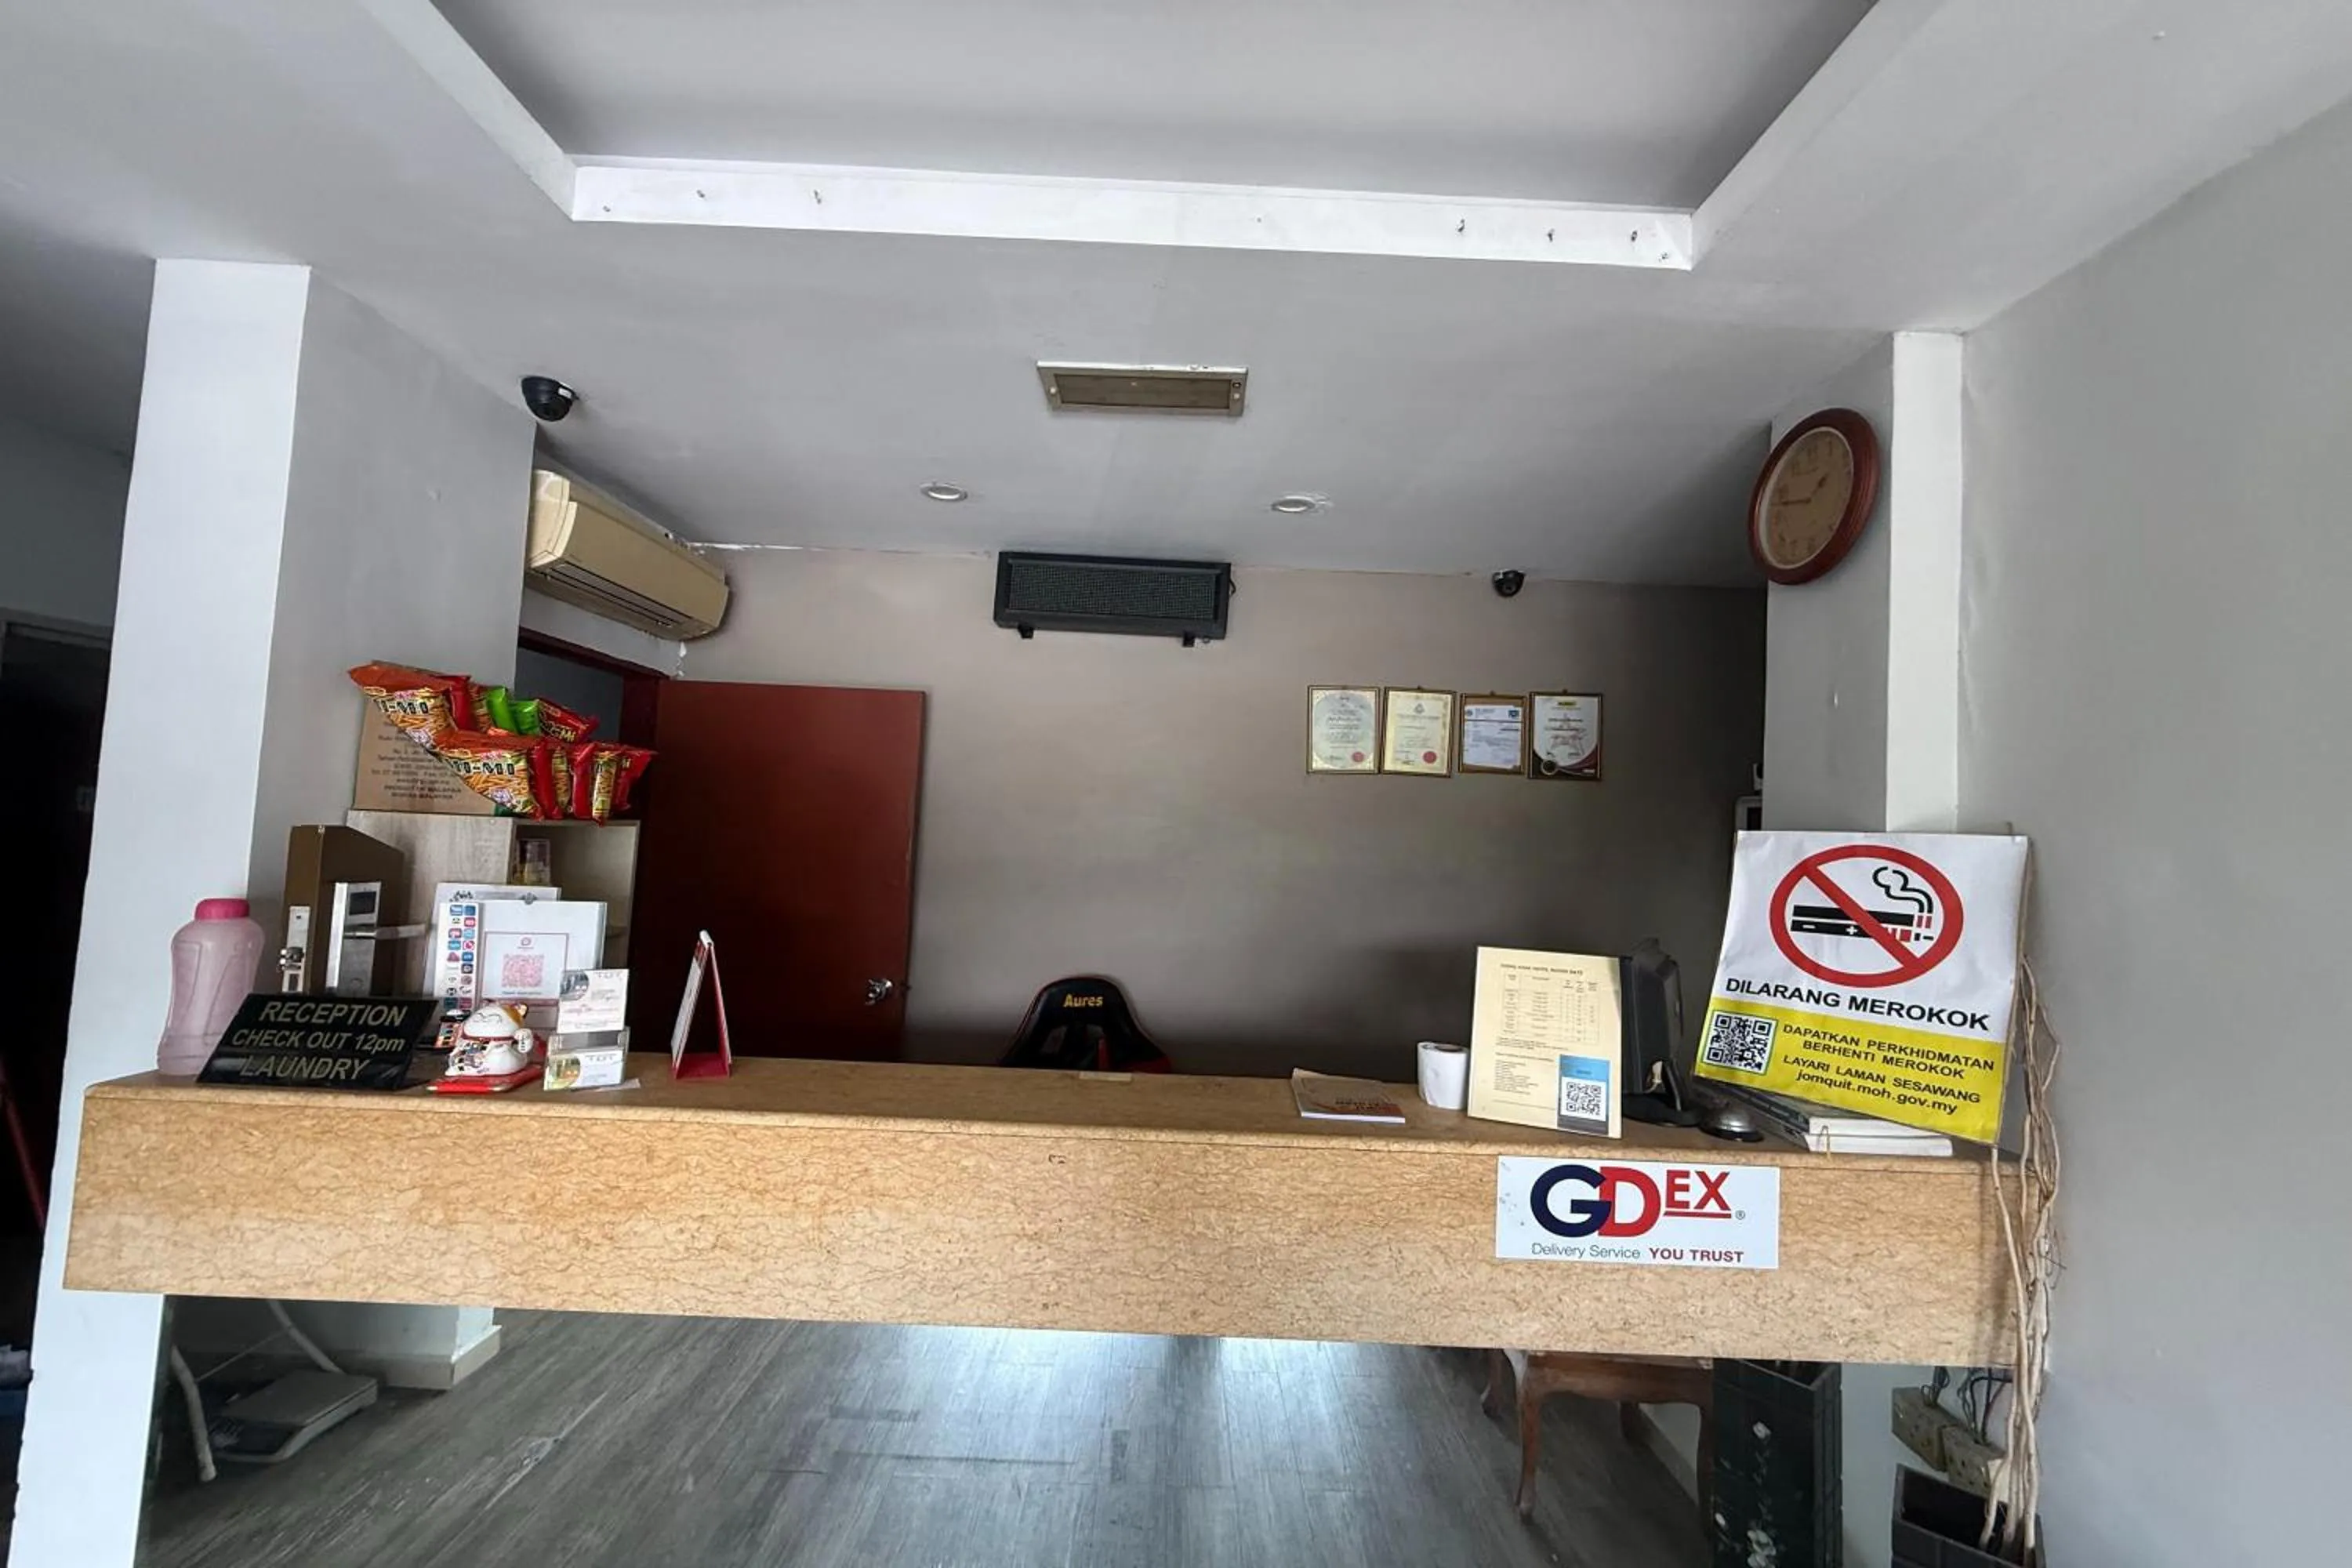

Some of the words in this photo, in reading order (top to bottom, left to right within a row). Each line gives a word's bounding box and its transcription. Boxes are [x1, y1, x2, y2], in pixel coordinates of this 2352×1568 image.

[259, 1001, 408, 1027] RECEPTION
[1063, 993, 1104, 1007] Aures
[1726, 978, 1841, 1007] DILARANG
[1848, 995, 1991, 1031] MEROKOK
[232, 1029, 301, 1047] CHECK
[307, 1033, 351, 1050] OUT
[354, 1033, 405, 1054] 12pm
[1783, 1023, 1860, 1047] DAPATKAN
[1867, 1039, 1994, 1071] PERKHIDMATAN
[240, 1058, 371, 1080] LAUNDRY
[1802, 1040, 1875, 1062] BERHENTI
[1882, 1055, 1965, 1080] MEROKOK
[1783, 1055, 1831, 1073] LAYARI
[1835, 1066, 1886, 1084] LAMAN
[1892, 1076, 1981, 1103] SESAWANG
[1795, 1069, 1958, 1115] jomquit.moh.gov.my
[1531, 1243, 1584, 1258] Delivery
[1589, 1245, 1641, 1260] Service
[1649, 1247, 1684, 1261] YOU
[1689, 1249, 1744, 1263] TRUST
